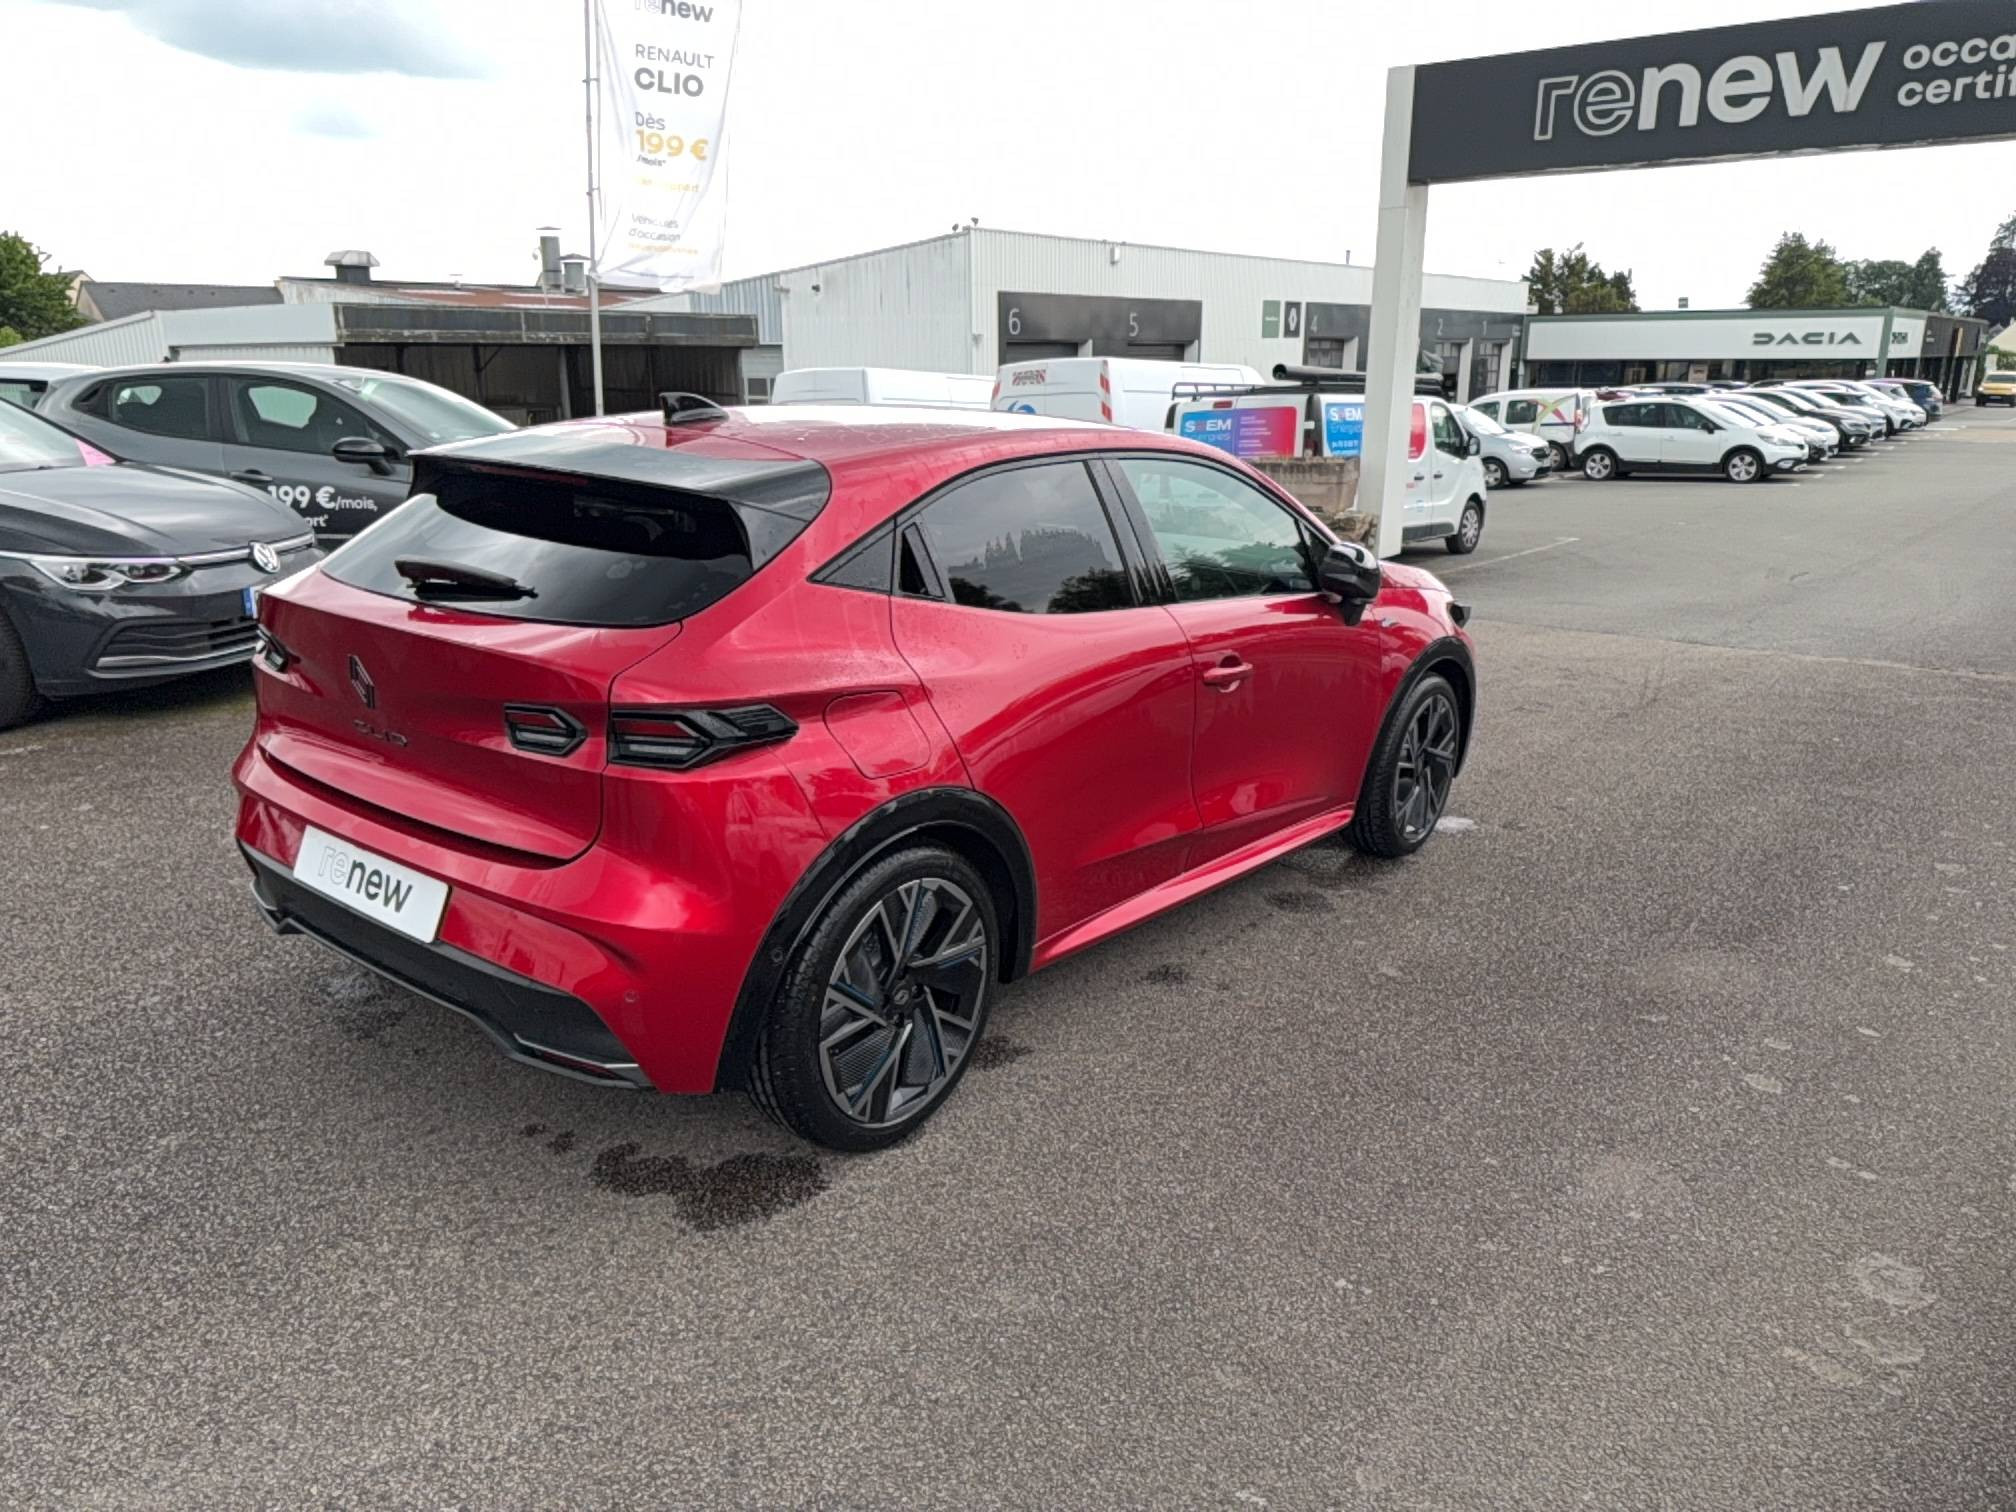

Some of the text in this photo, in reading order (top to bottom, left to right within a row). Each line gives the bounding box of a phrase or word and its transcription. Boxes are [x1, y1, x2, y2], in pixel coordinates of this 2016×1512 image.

[635, 43, 715, 69] RENAULT
[634, 67, 704, 97] CLIO
[1533, 40, 1887, 141] renew
[635, 111, 666, 130] Dès
[636, 129, 709, 162] 199 €
[1008, 308, 1021, 336] 6
[1128, 312, 1140, 337] 5
[1310, 315, 1318, 333] 4
[1752, 332, 1862, 345] DACIA
[267, 485, 311, 509] 199
[317, 846, 413, 914] renew
